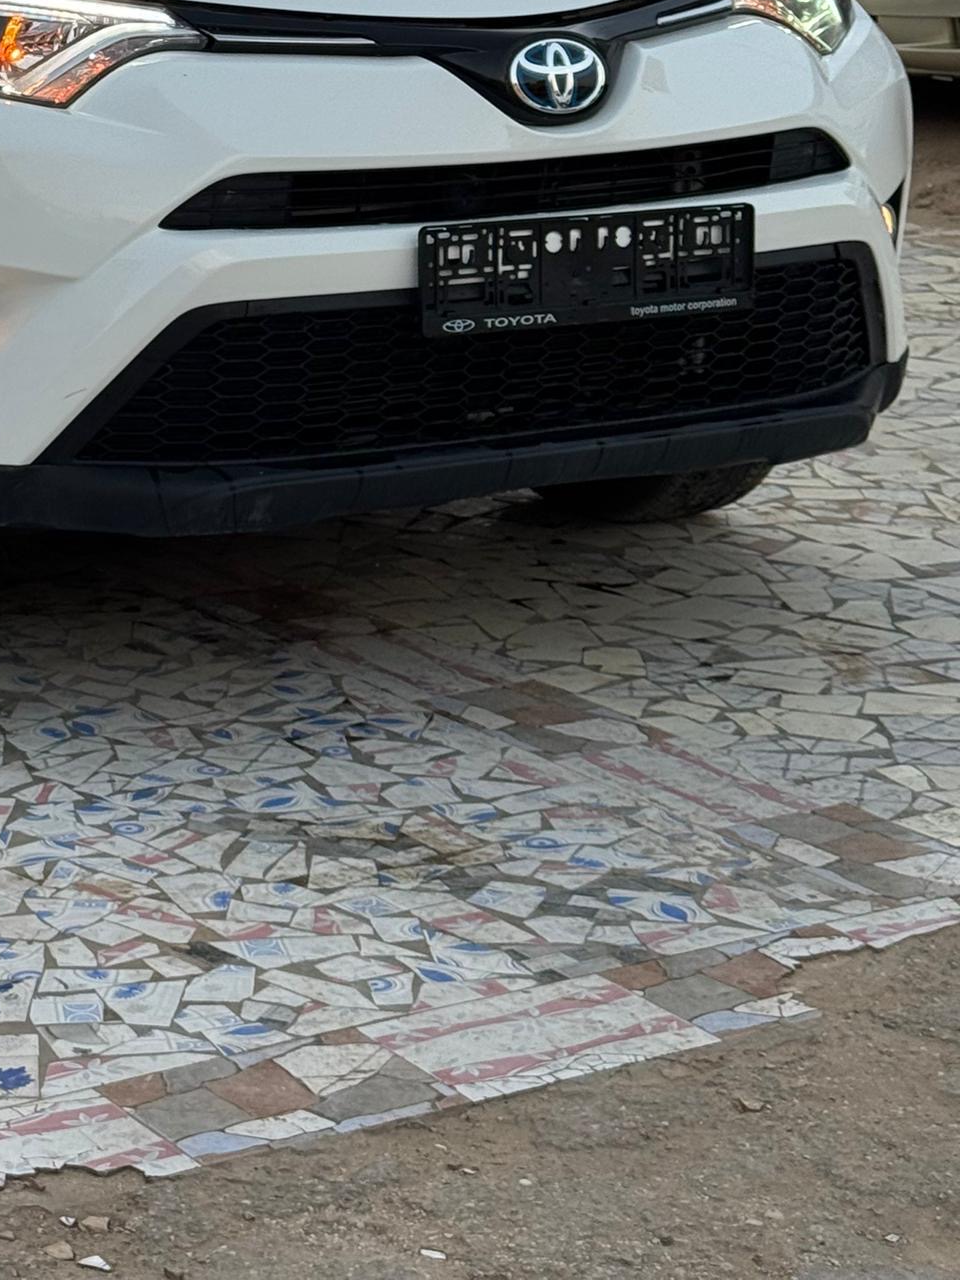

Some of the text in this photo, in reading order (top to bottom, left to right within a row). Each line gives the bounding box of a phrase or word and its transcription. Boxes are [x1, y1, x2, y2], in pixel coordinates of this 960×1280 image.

[630, 297, 737, 318] toyota motor corporation
[483, 313, 557, 328] TOYOTA
